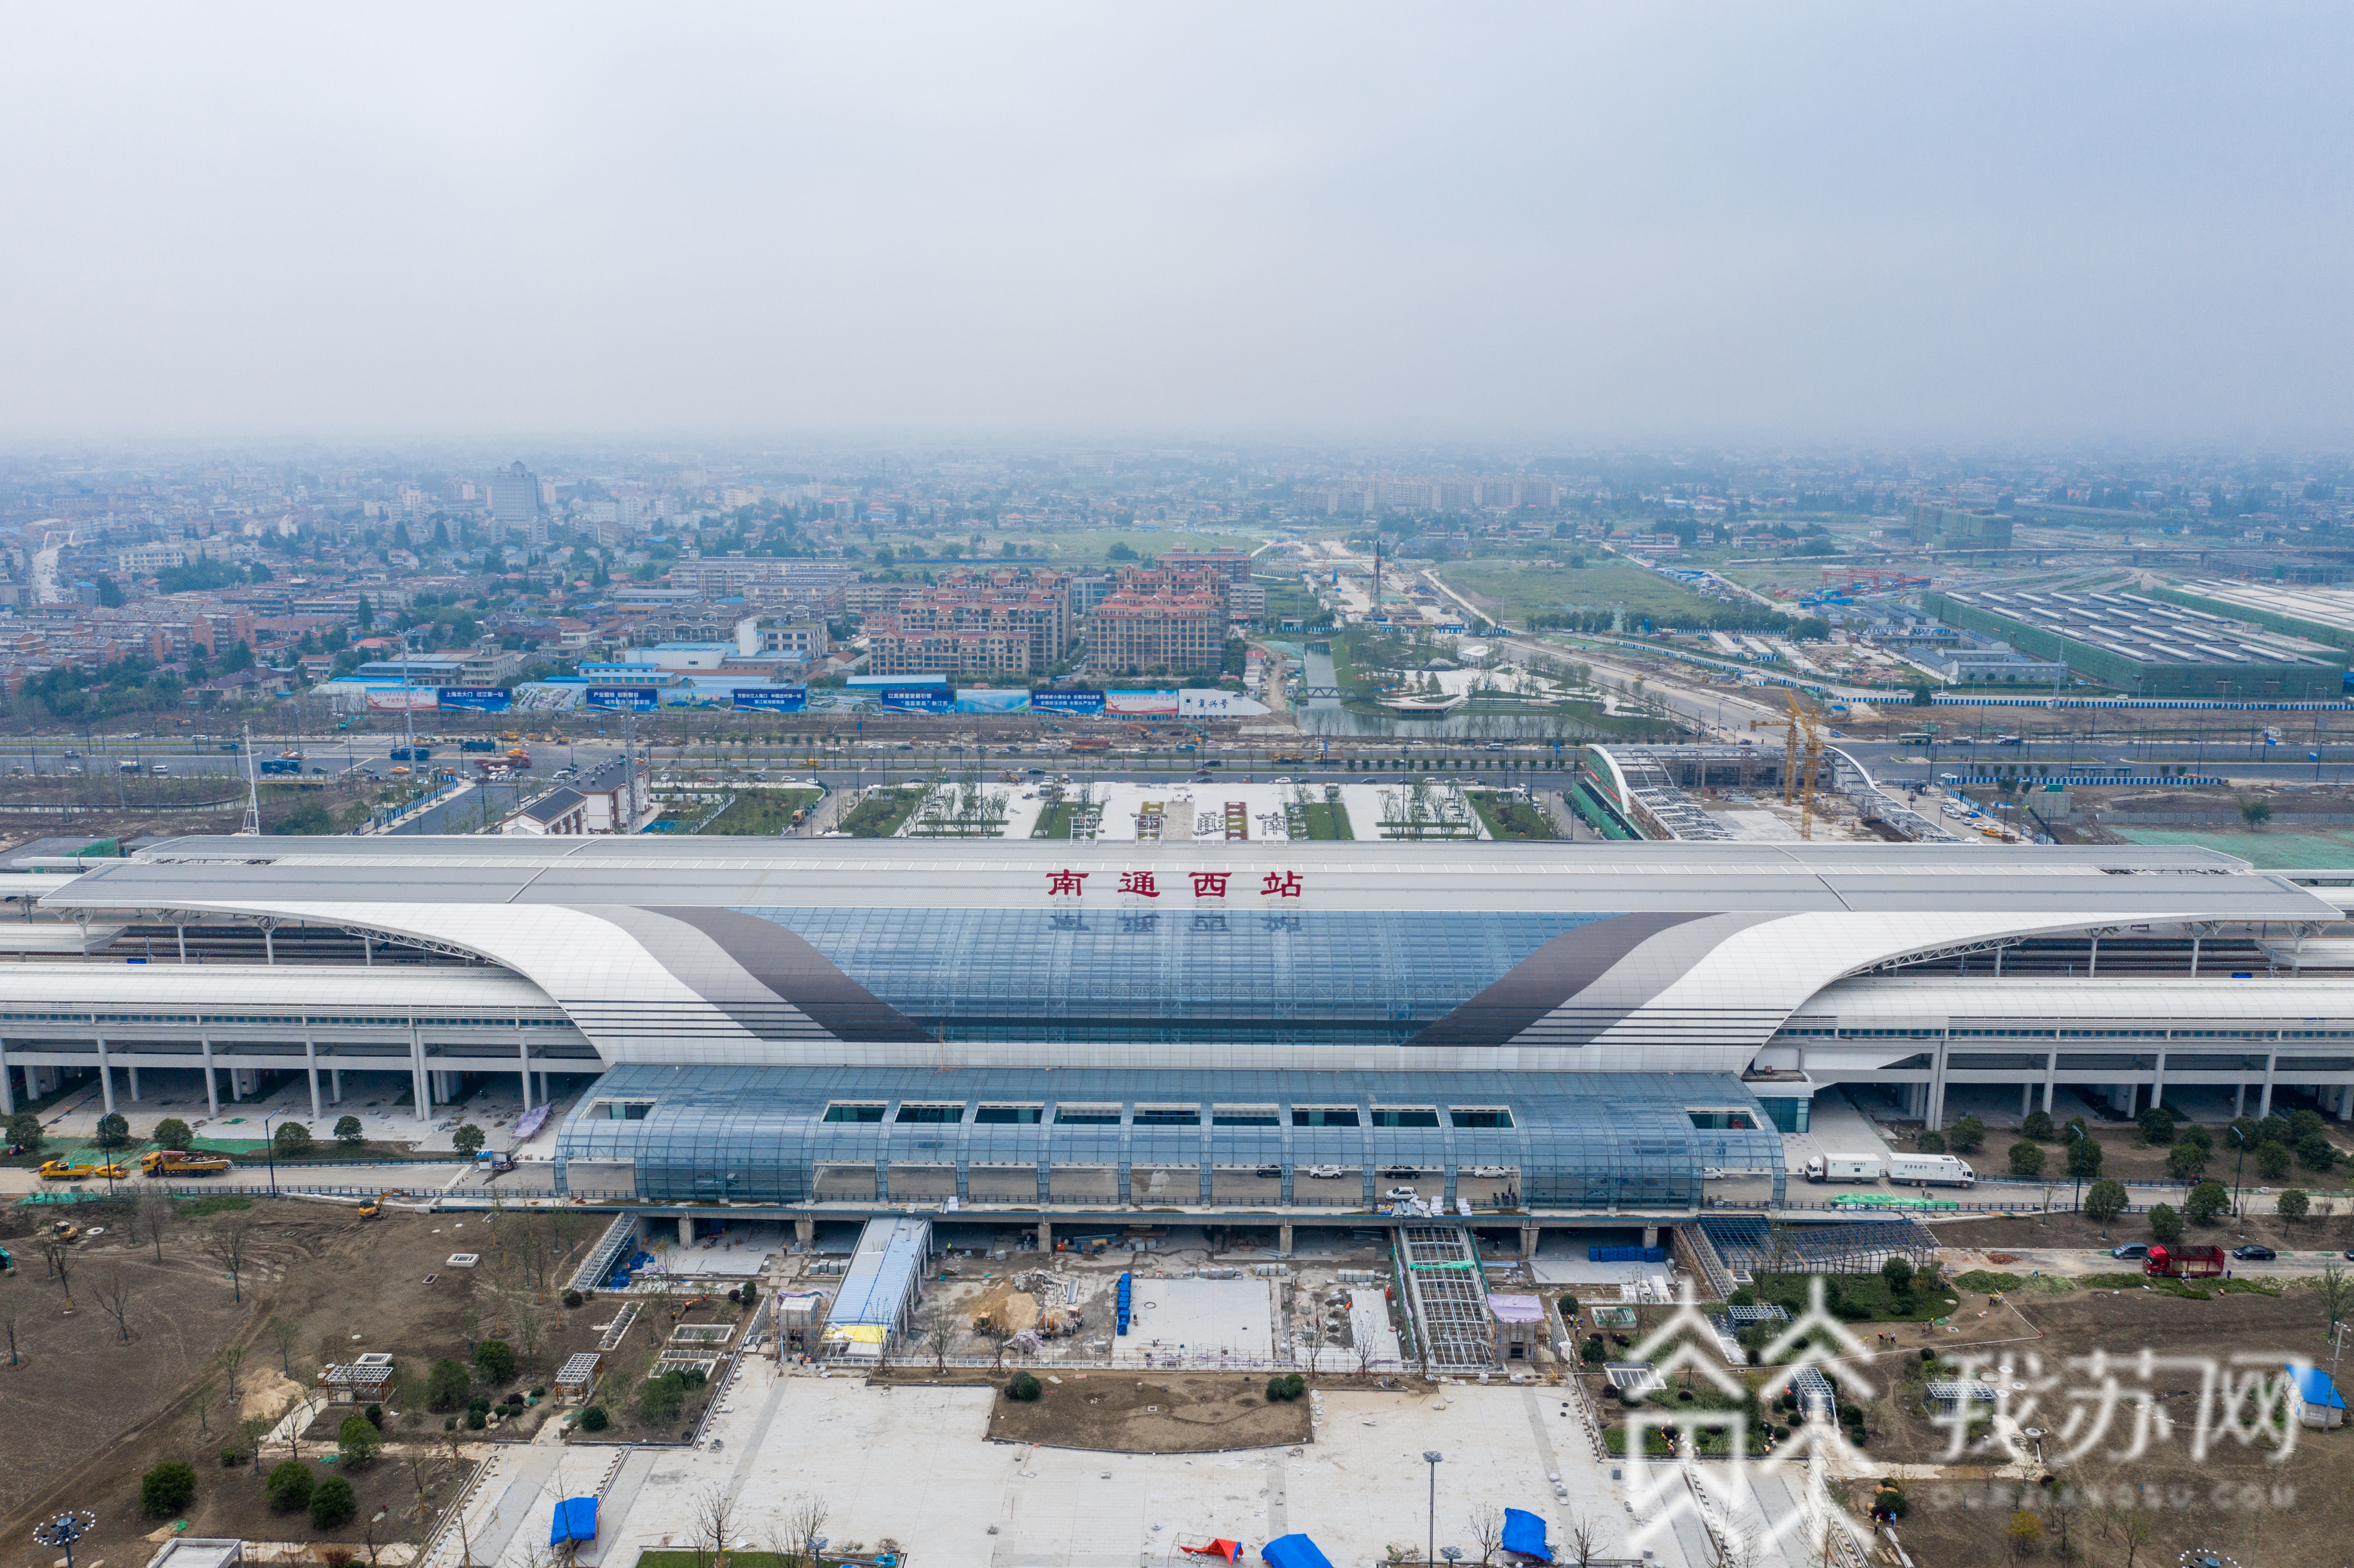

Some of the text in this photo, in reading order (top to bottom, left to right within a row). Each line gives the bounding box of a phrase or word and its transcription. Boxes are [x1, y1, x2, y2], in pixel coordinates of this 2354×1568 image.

[1198, 698, 1228, 709] 复兴号
[1046, 869, 1303, 897] 南通西站
